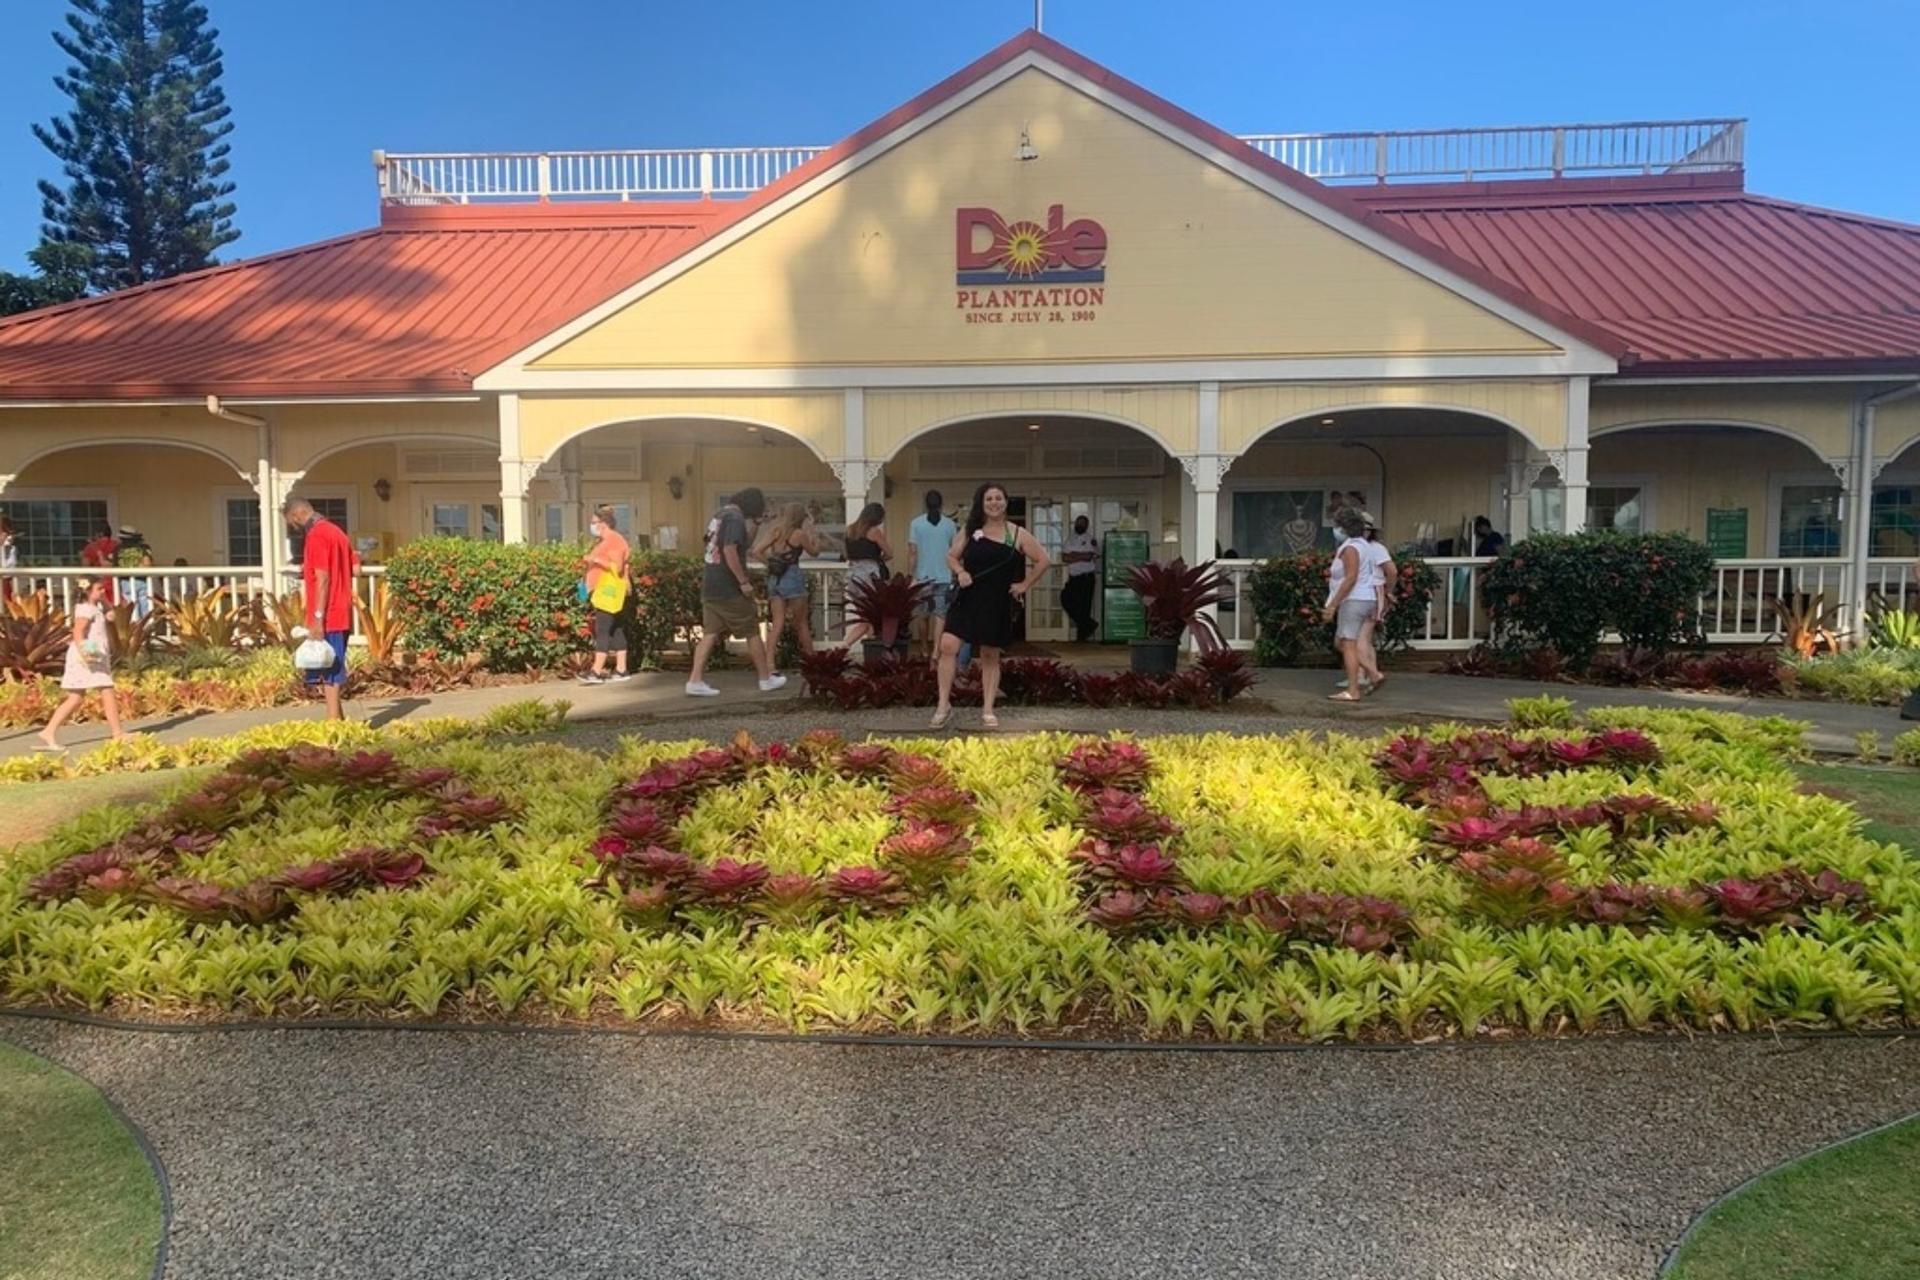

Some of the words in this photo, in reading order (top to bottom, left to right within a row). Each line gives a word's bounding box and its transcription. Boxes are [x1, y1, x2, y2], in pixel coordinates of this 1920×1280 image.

[957, 204, 1107, 275] Dole
[956, 288, 1105, 308] PLANTATION
[965, 312, 1003, 324] SINCE
[1010, 311, 1041, 323] JULY
